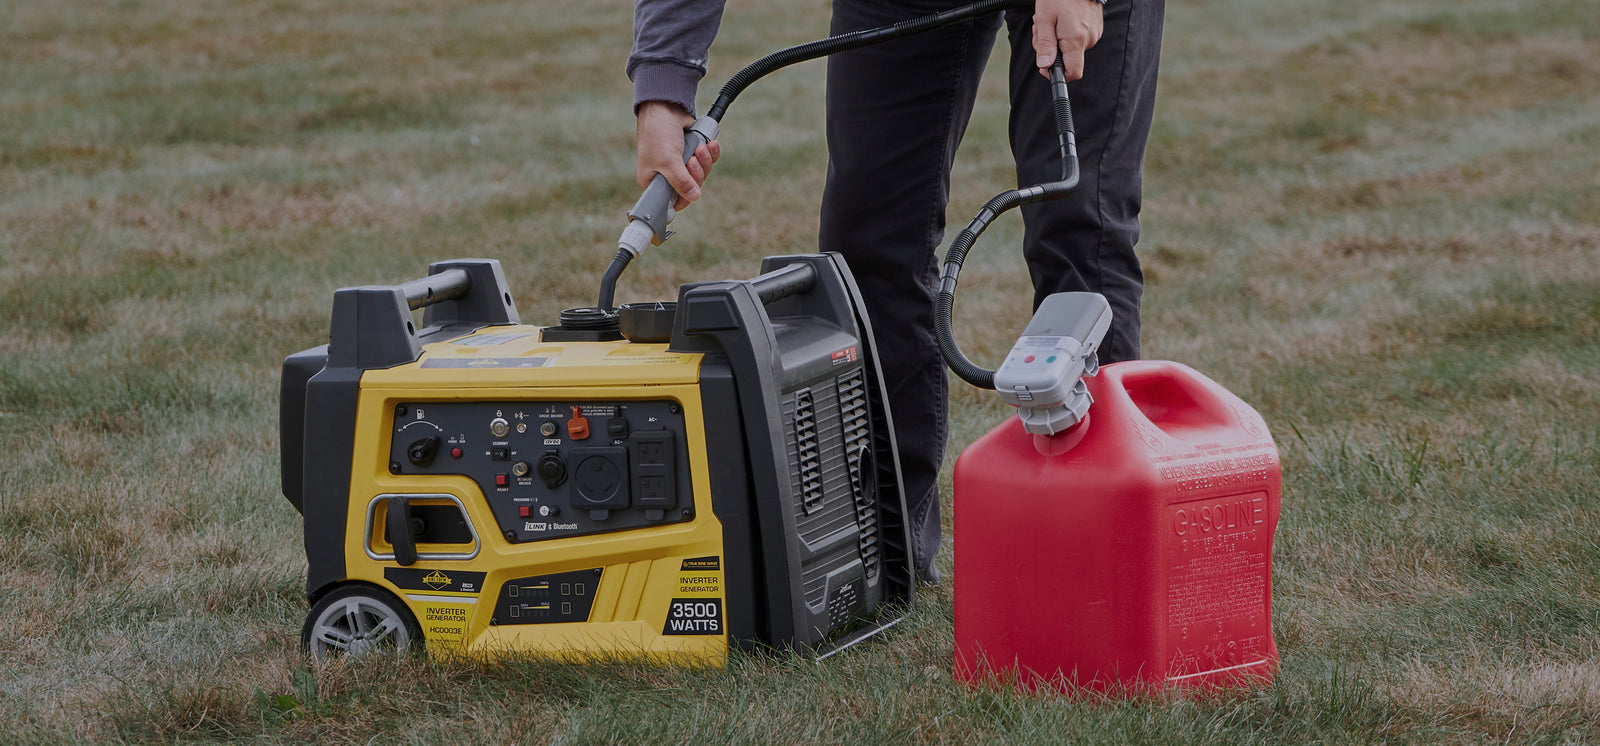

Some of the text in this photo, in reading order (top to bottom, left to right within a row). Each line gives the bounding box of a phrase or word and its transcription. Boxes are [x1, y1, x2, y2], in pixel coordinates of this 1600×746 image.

[1173, 498, 1264, 537] GASOLINE
[553, 522, 578, 530] Bluetooth
[680, 576, 718, 584] INVERTER
[426, 607, 466, 616] INVERTER
[673, 602, 717, 618] 3500
[426, 614, 466, 622] GENERATOR
[670, 619, 719, 631] WATTS
